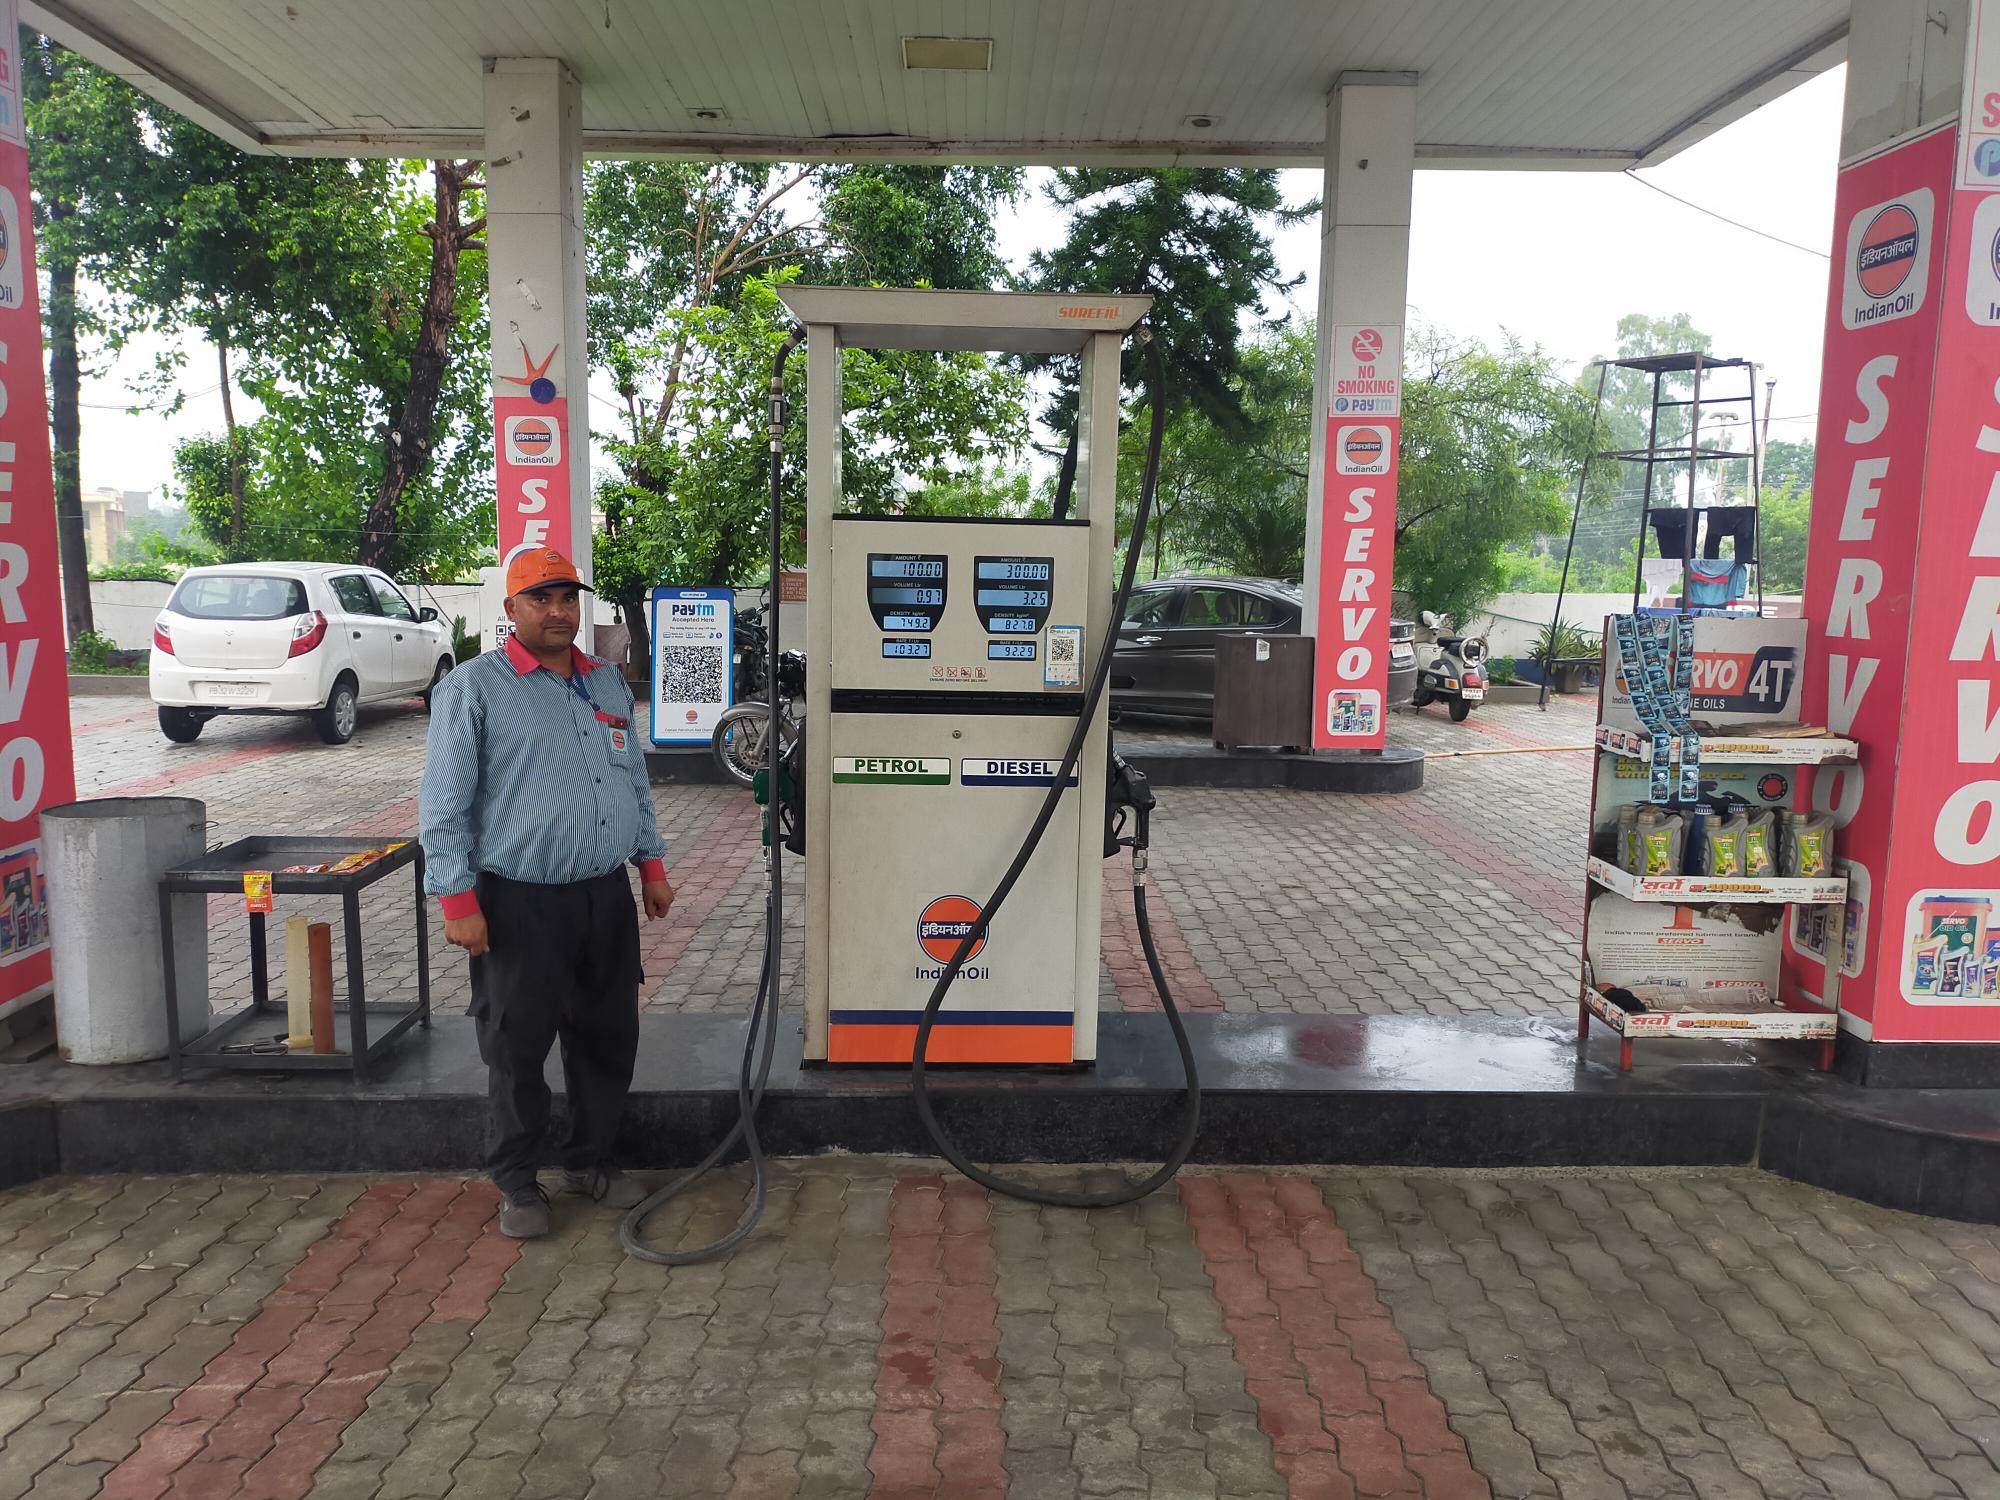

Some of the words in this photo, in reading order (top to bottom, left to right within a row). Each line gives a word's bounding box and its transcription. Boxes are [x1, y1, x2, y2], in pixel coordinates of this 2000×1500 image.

[1854, 293, 1914, 323] IndianOil
[1358, 365, 1376, 379] NO
[1337, 380, 1395, 394] SMOKING
[514, 455, 554, 465] IndianOil
[1345, 465, 1383, 474] IndianOil
[903, 562, 942, 577] 100.00
[1006, 564, 1048, 579] 300.00
[1336, 487, 1377, 681] SERVO
[916, 589, 941, 604] 0.97
[1023, 591, 1047, 606] 3.25
[1812, 355, 1899, 830] SERVO
[672, 602, 715, 616] paytm
[900, 617, 929, 629] 749.2
[1005, 619, 1034, 631] 827.8
[894, 644, 929, 655] 103.27
[1004, 646, 1034, 657] 92.29
[1692, 658, 1739, 690] RVO
[1748, 659, 1793, 703] 4T
[1702, 699, 1726, 710] OILS
[854, 758, 929, 773] PETROL
[986, 761, 1054, 775] DIESEL
[922, 922, 973, 938] इंडियनऑ
[1655, 930, 1695, 938] preferred
[1660, 937, 1703, 945] SERVO
[915, 966, 989, 980] IndnOil
